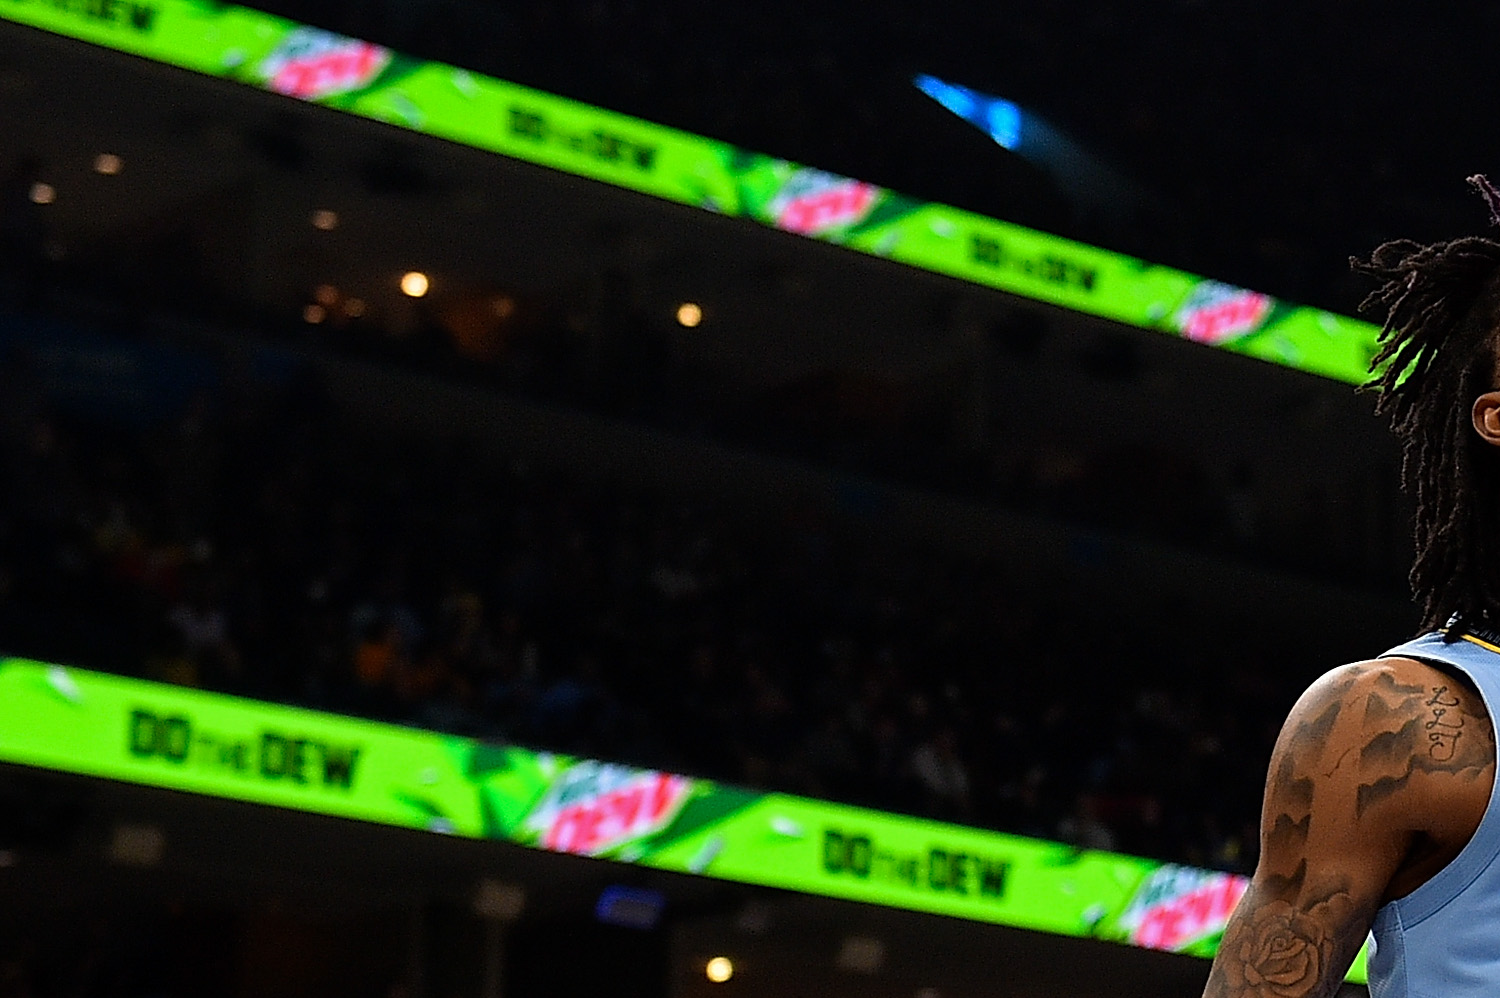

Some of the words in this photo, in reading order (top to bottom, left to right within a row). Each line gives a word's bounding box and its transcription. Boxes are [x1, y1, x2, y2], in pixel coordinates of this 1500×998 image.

[128, 708, 191, 762] DO
[259, 731, 363, 788] DEW
[823, 829, 873, 879] DO
[926, 847, 1012, 899] DEW
